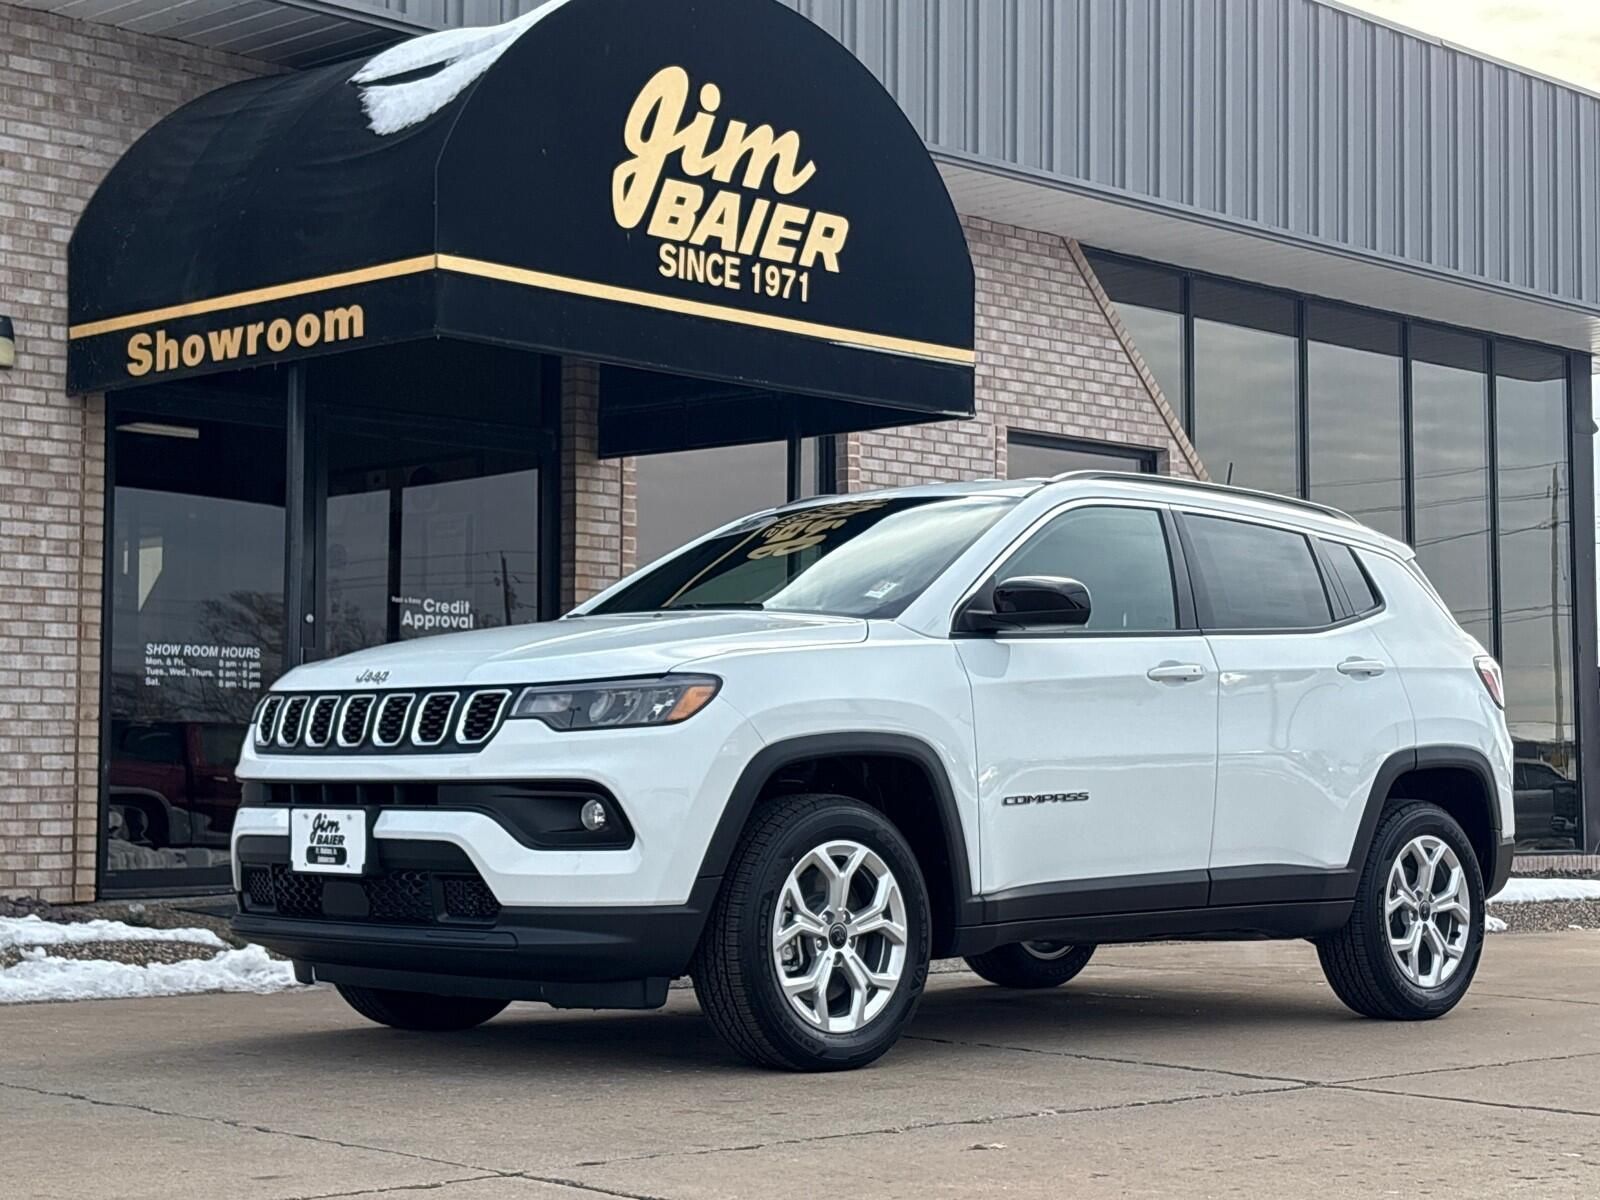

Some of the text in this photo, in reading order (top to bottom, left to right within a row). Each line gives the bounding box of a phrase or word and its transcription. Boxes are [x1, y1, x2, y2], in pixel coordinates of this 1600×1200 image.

[612, 66, 816, 228] Jim
[647, 178, 849, 273] BAIER
[658, 243, 809, 302] SINCE 1971
[127, 304, 364, 376] Showroom
[423, 598, 470, 614] Credit
[401, 610, 474, 630] Approval
[145, 643, 260, 659] SHOW ROOM HOURS
[145, 657, 164, 665] Mon.
[1001, 791, 1090, 806] COMPASS
[310, 813, 340, 844] Jim
[316, 834, 345, 846] BAIER
